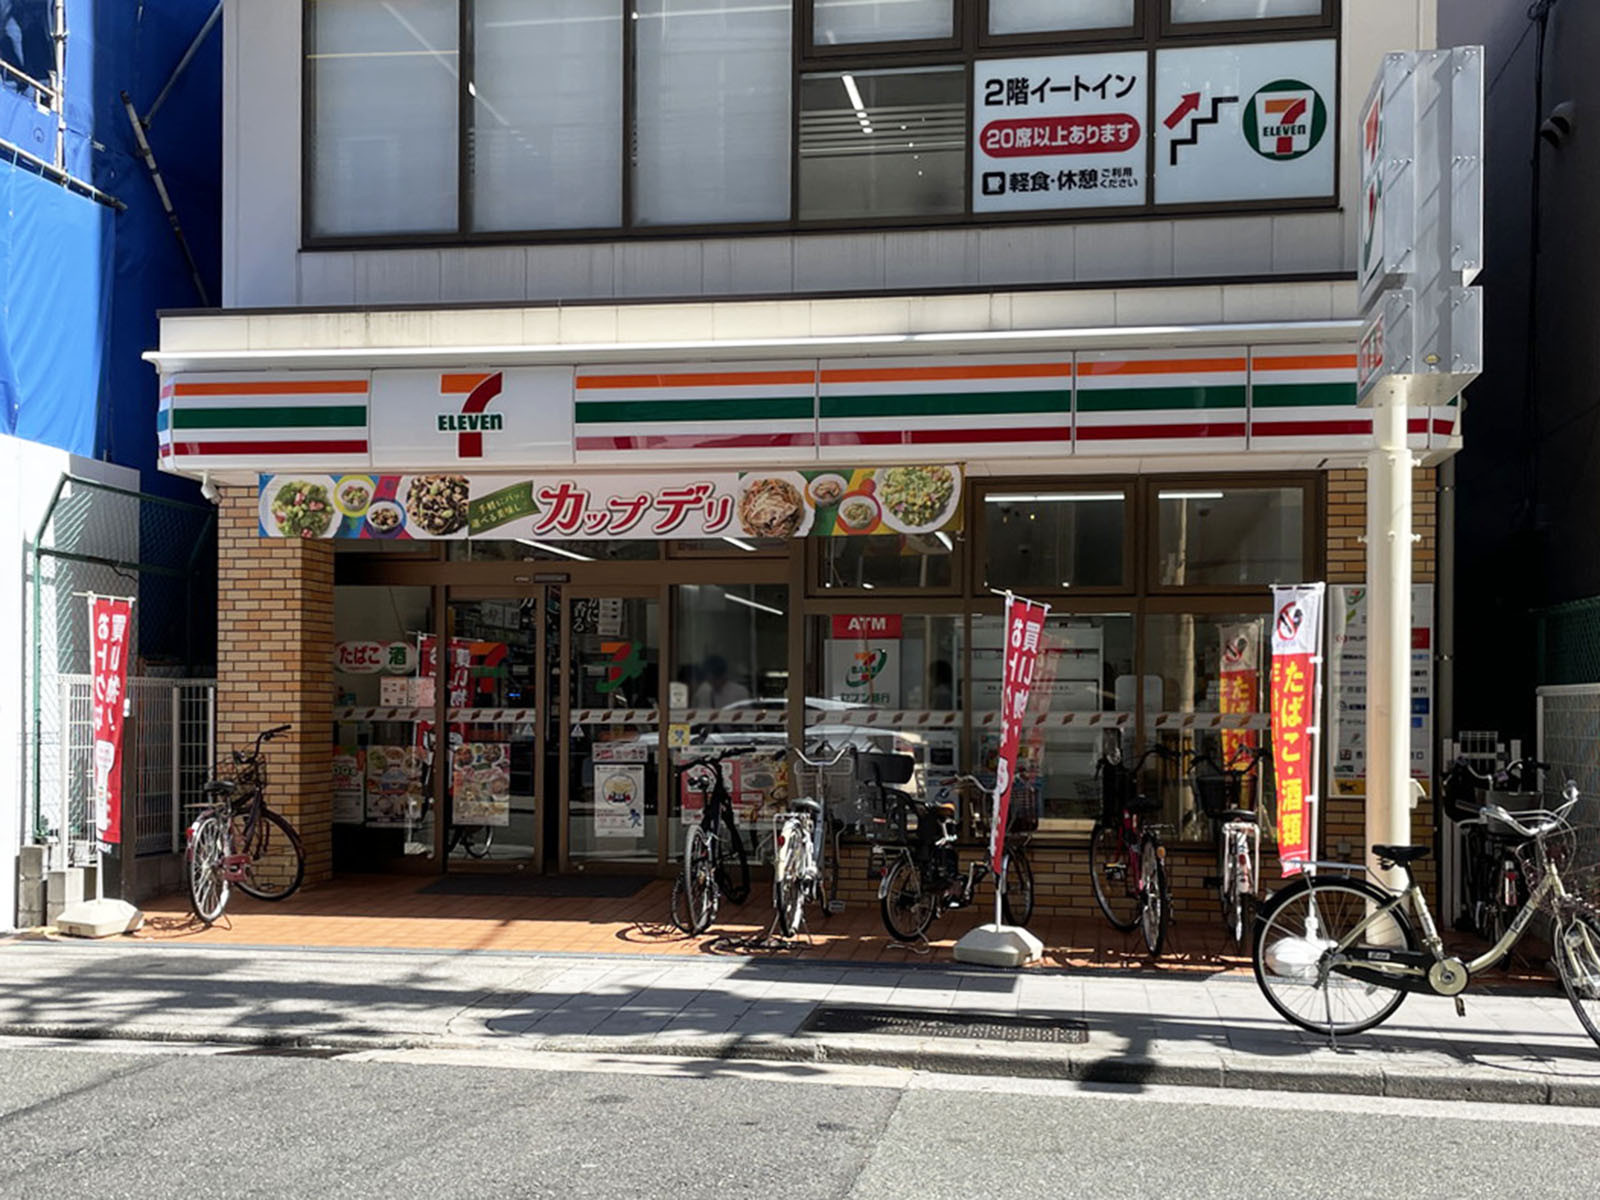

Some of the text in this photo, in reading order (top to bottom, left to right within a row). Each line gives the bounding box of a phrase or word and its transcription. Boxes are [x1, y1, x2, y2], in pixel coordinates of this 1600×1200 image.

[984, 73, 1136, 106] 2階イートイン
[985, 123, 1134, 149] 20席以上あります
[1265, 97, 1306, 153] 7
[1100, 178, 1138, 189] ください
[441, 371, 503, 458] 7
[533, 482, 733, 533] カップデリ
[847, 617, 887, 631] ATM
[340, 645, 380, 664] たばこ
[389, 646, 407, 665] 酒
[1280, 660, 1305, 847] たばこ・酒類
